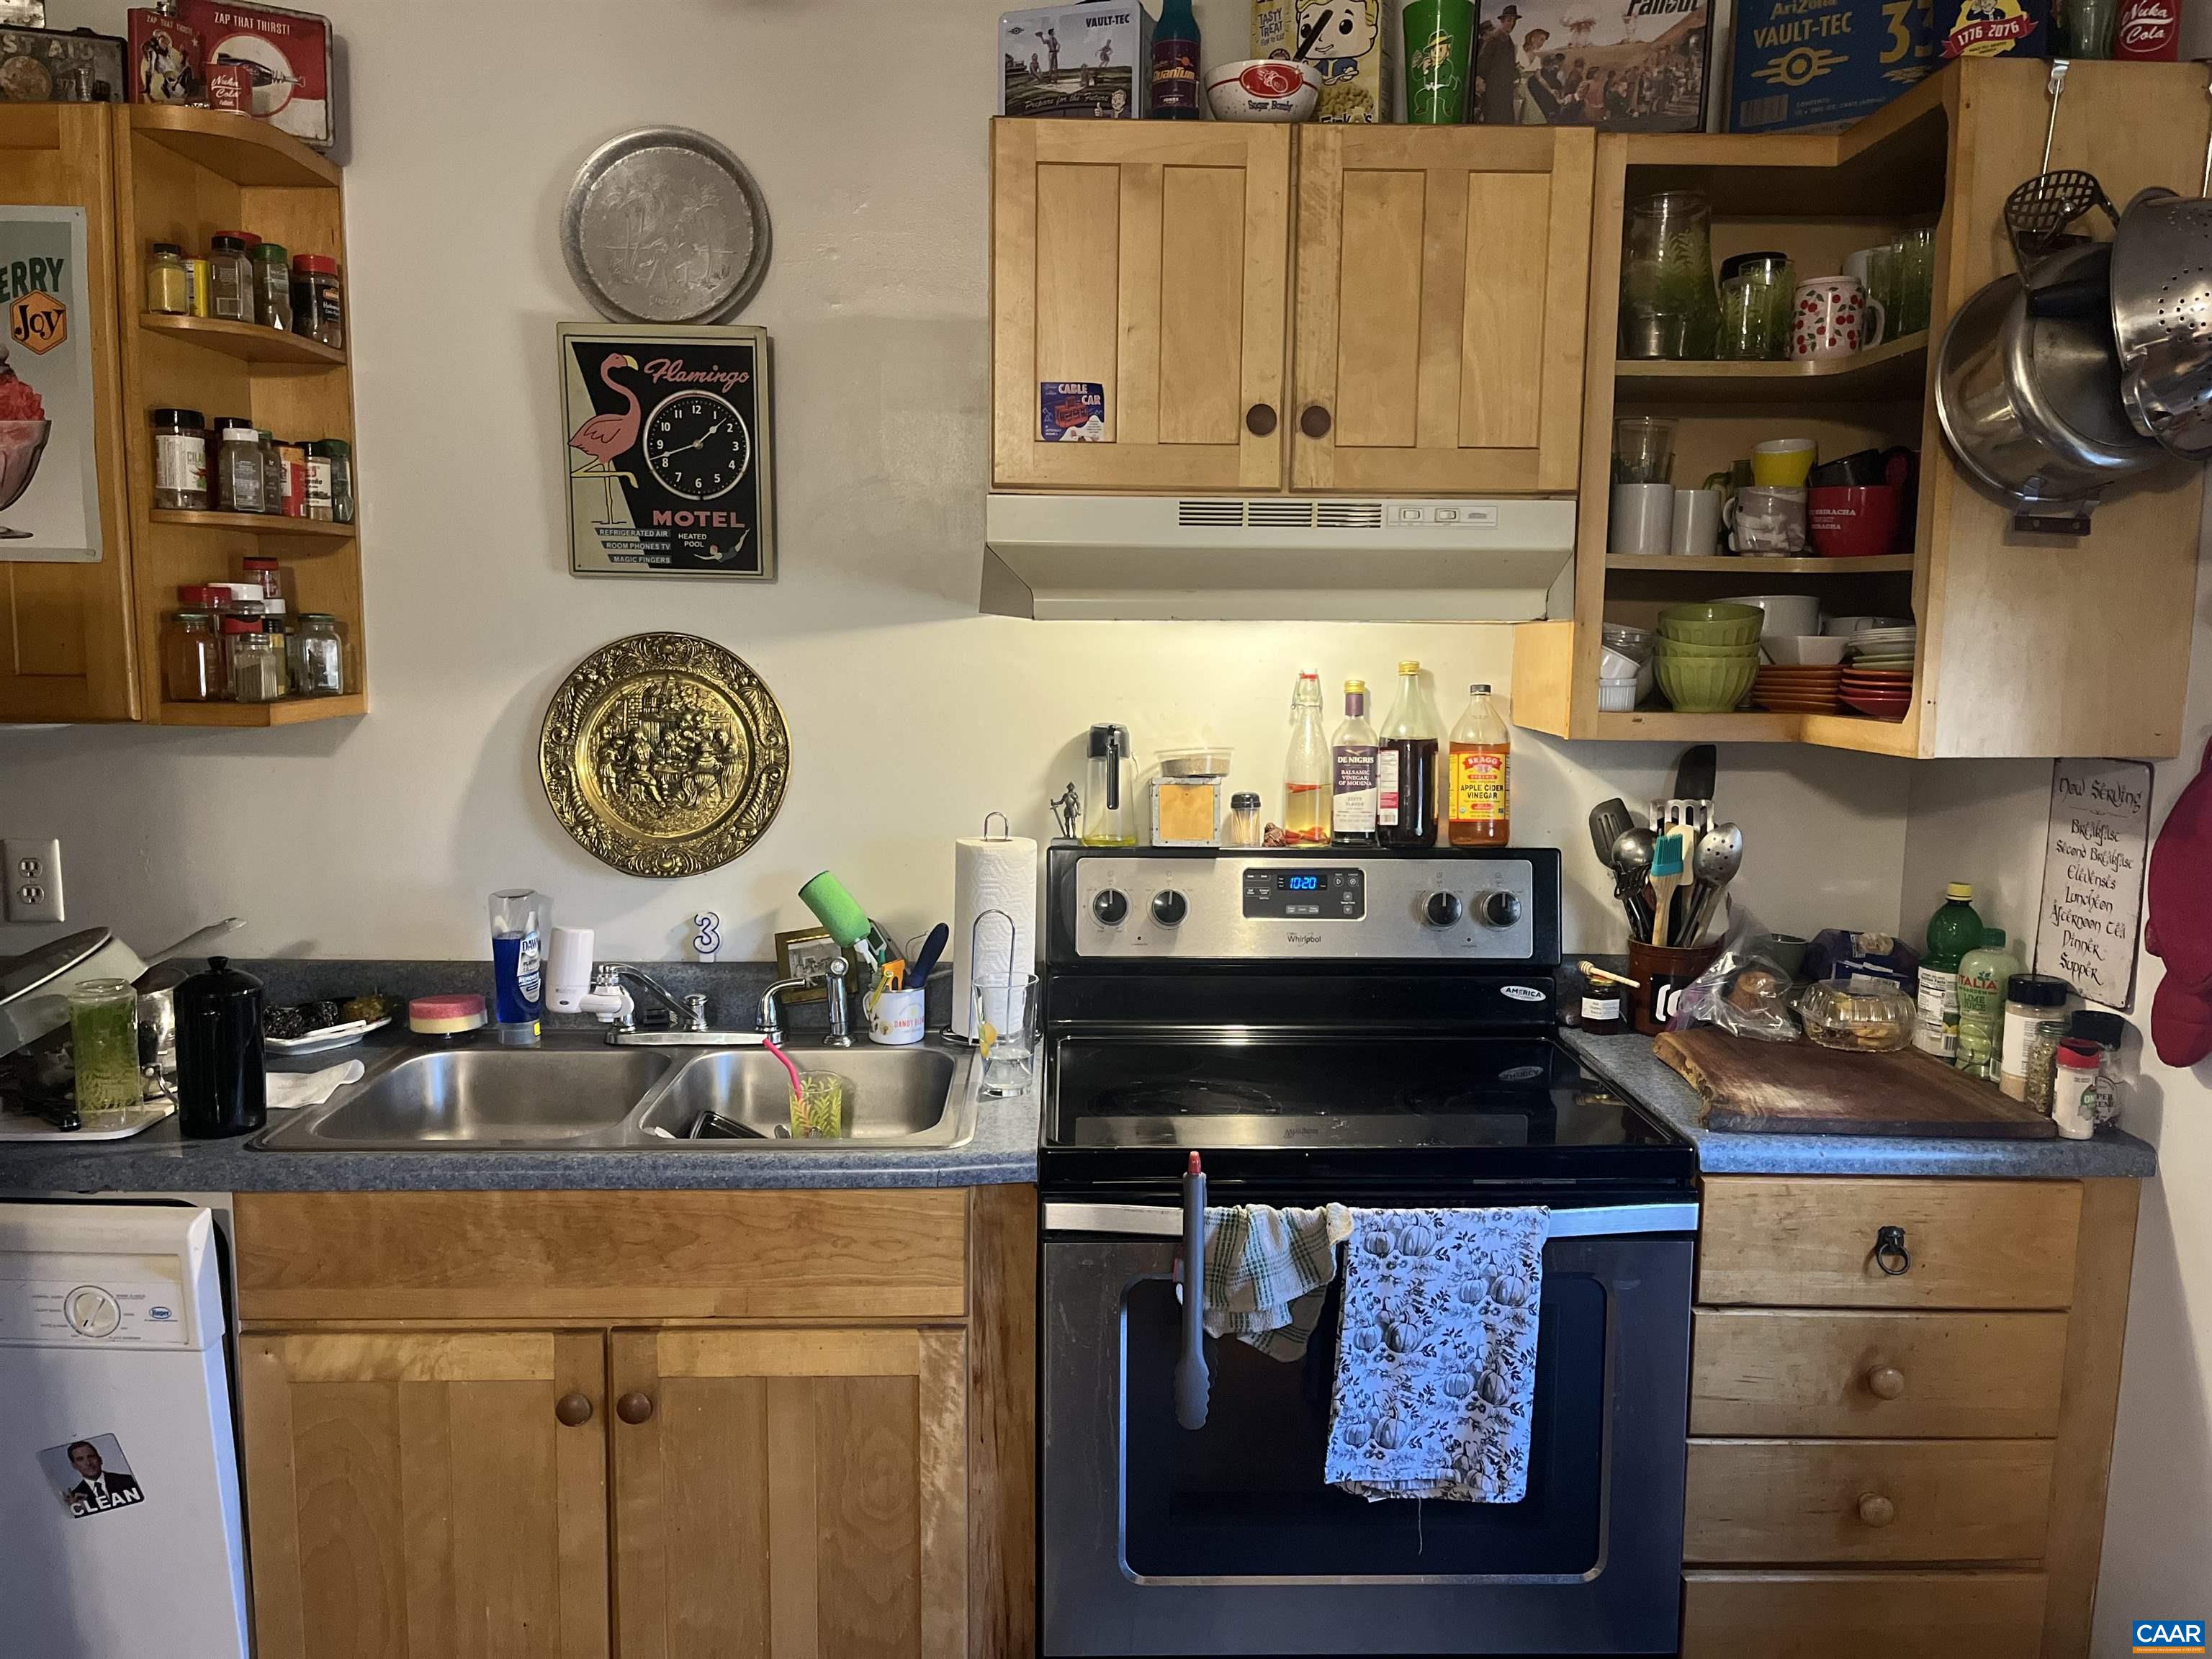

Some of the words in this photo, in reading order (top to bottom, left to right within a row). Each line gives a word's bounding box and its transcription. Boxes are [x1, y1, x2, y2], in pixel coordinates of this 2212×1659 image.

[1086, 14, 1130, 28] VAULT-TEC
[1257, 7, 1282, 24] TASTY
[215, 12, 230, 24] ZAP
[234, 15, 253, 29] THAT
[257, 19, 290, 35] THIRST!
[1259, 21, 1283, 37] TREAT
[1753, 12, 1853, 49] VAULT-TEC
[1958, 26, 1983, 46] 1776
[1988, 21, 2020, 37] 2076
[2126, 26, 2165, 44] Cola
[215, 88, 241, 98] Cola
[1025, 99, 1054, 109] Prepare
[1083, 92, 1109, 102] Future
[644, 359, 750, 394] Flamingo
[1058, 384, 1088, 395] CABLE
[1081, 395, 1101, 405] CAR
[675, 410, 683, 418] 11
[692, 405, 702, 415] 12
[713, 410, 717, 420] 1
[661, 422, 671, 431] 10
[727, 423, 734, 433] 2
[657, 439, 664, 449] 9
[732, 441, 739, 451] 3
[662, 458, 669, 467] 8
[728, 460, 736, 469] 4
[675, 472, 682, 482] 7
[695, 478, 702, 488] 6
[714, 474, 721, 483] 5
[652, 510, 745, 528] MOTEL
[1468, 756, 1498, 765] BRAGG
[2091, 780, 2143, 814] Serving
[2056, 840, 2087, 861] Second
[1290, 876, 1317, 889] 10:20
[2065, 886, 2114, 914] Luncheon
[2051, 900, 2101, 933] Afternoon
[693, 910, 721, 954] 3
[522, 938, 538, 952] DAW
[1287, 935, 1321, 944] Whirlpool
[2062, 930, 2105, 961] Dinner
[2059, 952, 2104, 986] Supper
[1959, 974, 1997, 991] ITALIA
[1506, 987, 1542, 998] AMERICA
[1964, 993, 1985, 1004] LIME
[1964, 1002, 1986, 1011] JUICE
[894, 1019, 913, 1028] DANDY
[70, 1488, 141, 1516] CLEAN
